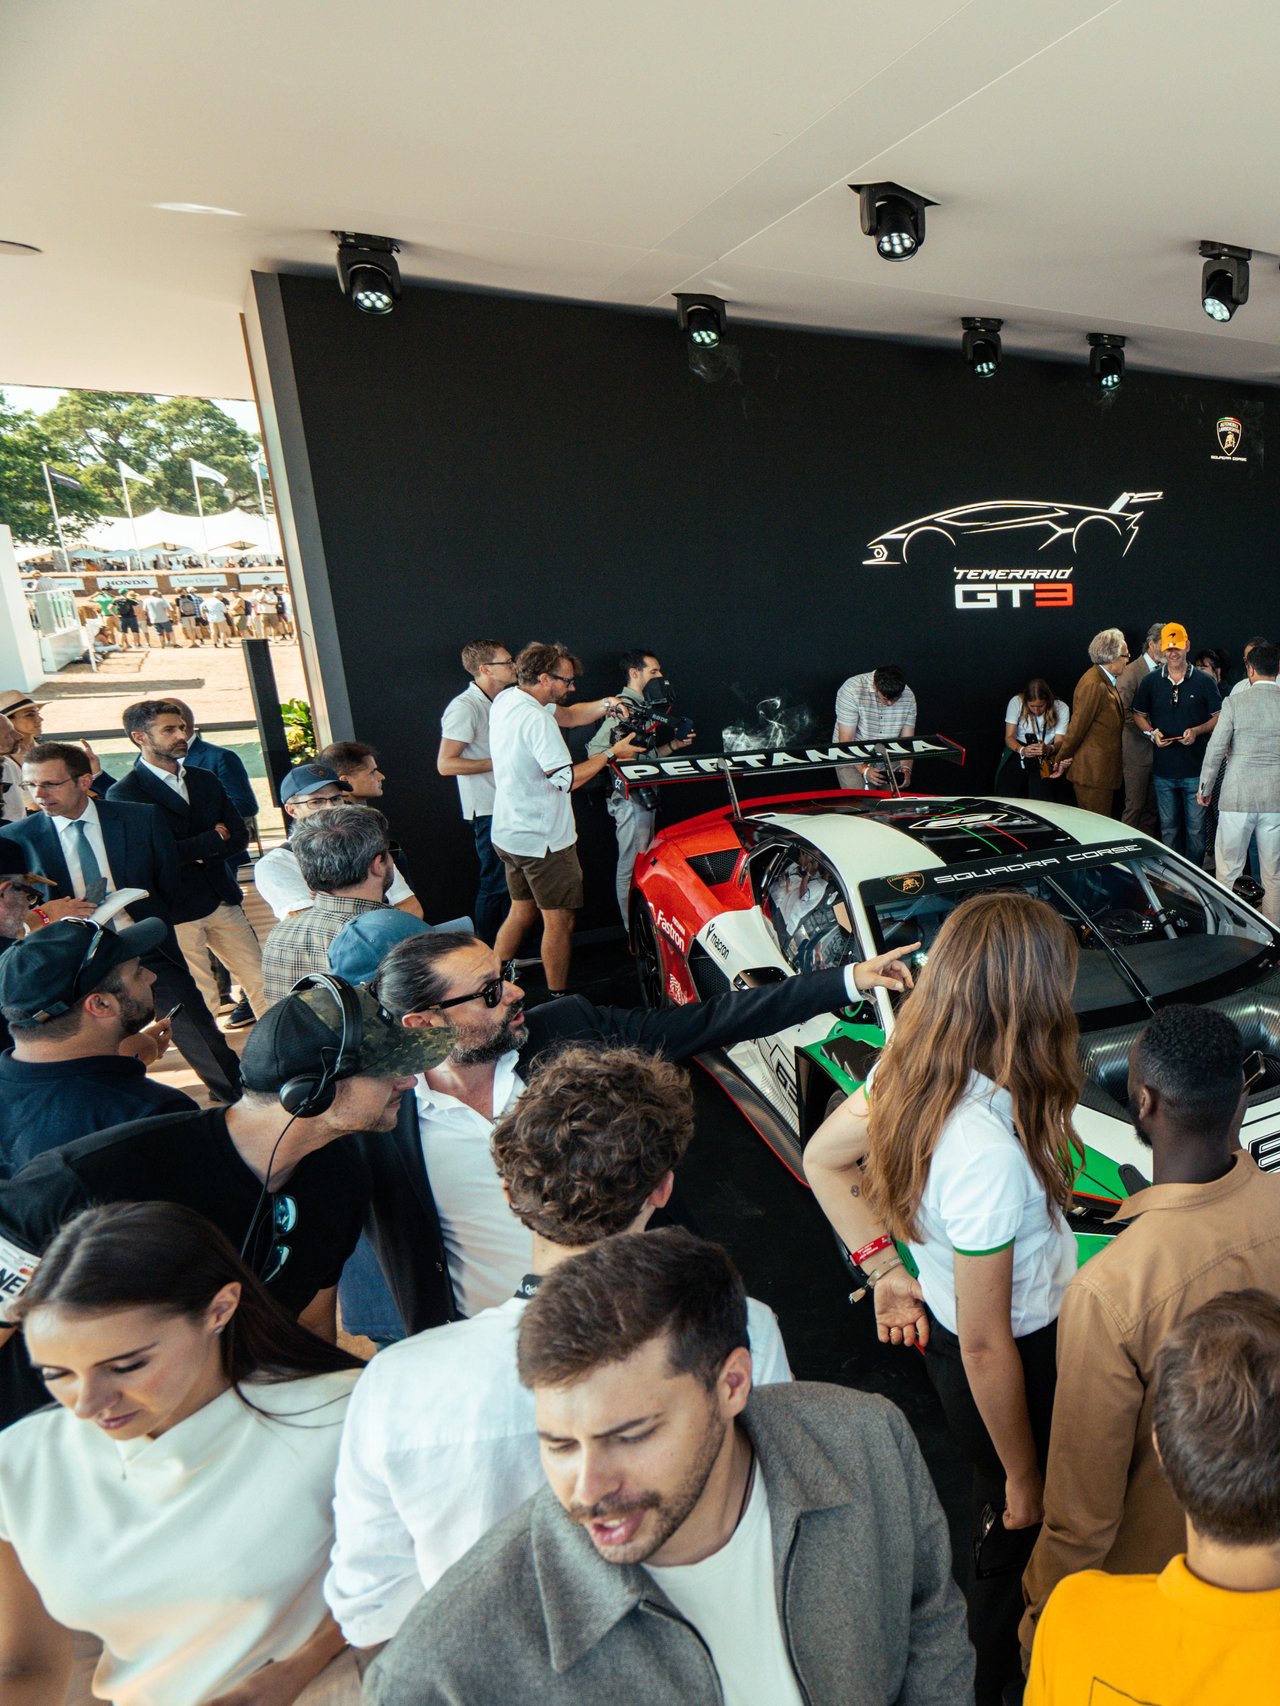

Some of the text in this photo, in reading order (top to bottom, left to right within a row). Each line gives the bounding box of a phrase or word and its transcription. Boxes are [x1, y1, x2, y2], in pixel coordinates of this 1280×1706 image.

[953, 566, 1074, 580] TEMERARIO
[954, 583, 1074, 609] GT3
[620, 740, 949, 780] PERTAMINA
[933, 858, 1060, 884] SQUADRA
[1066, 844, 1142, 863] CORSE
[656, 909, 685, 953] Fastron
[710, 932, 730, 961] macron
